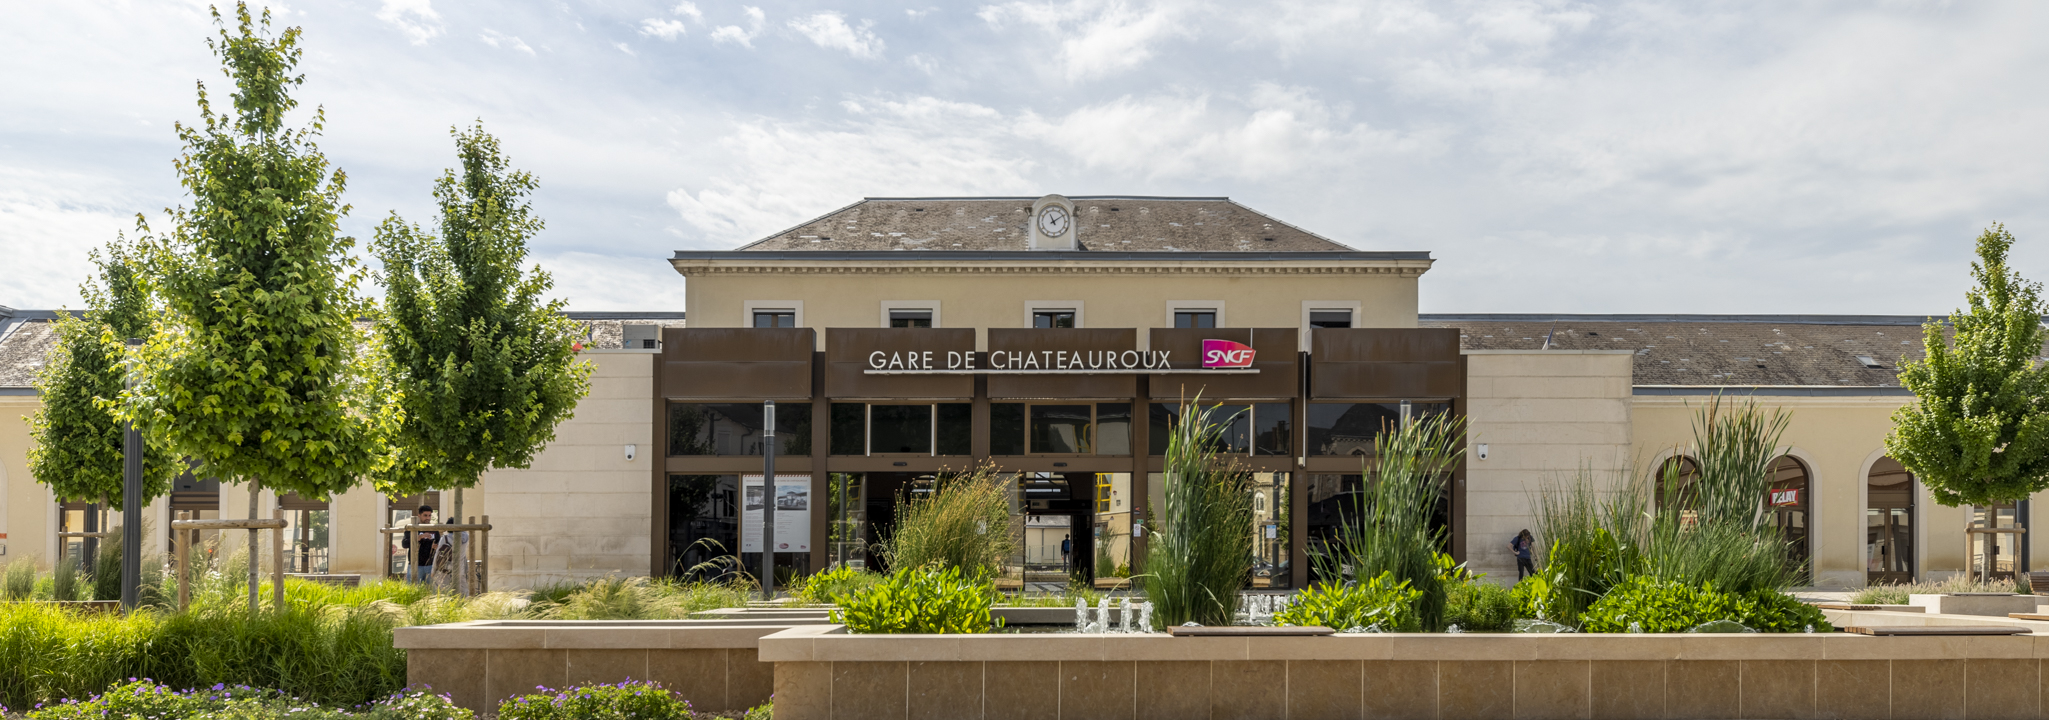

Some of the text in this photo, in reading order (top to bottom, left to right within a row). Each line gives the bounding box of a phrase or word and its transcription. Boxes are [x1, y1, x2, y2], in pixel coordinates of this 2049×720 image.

[869, 350, 1171, 370] GARE DE CHATEAUROUX
[1205, 349, 1253, 364] SNCF
